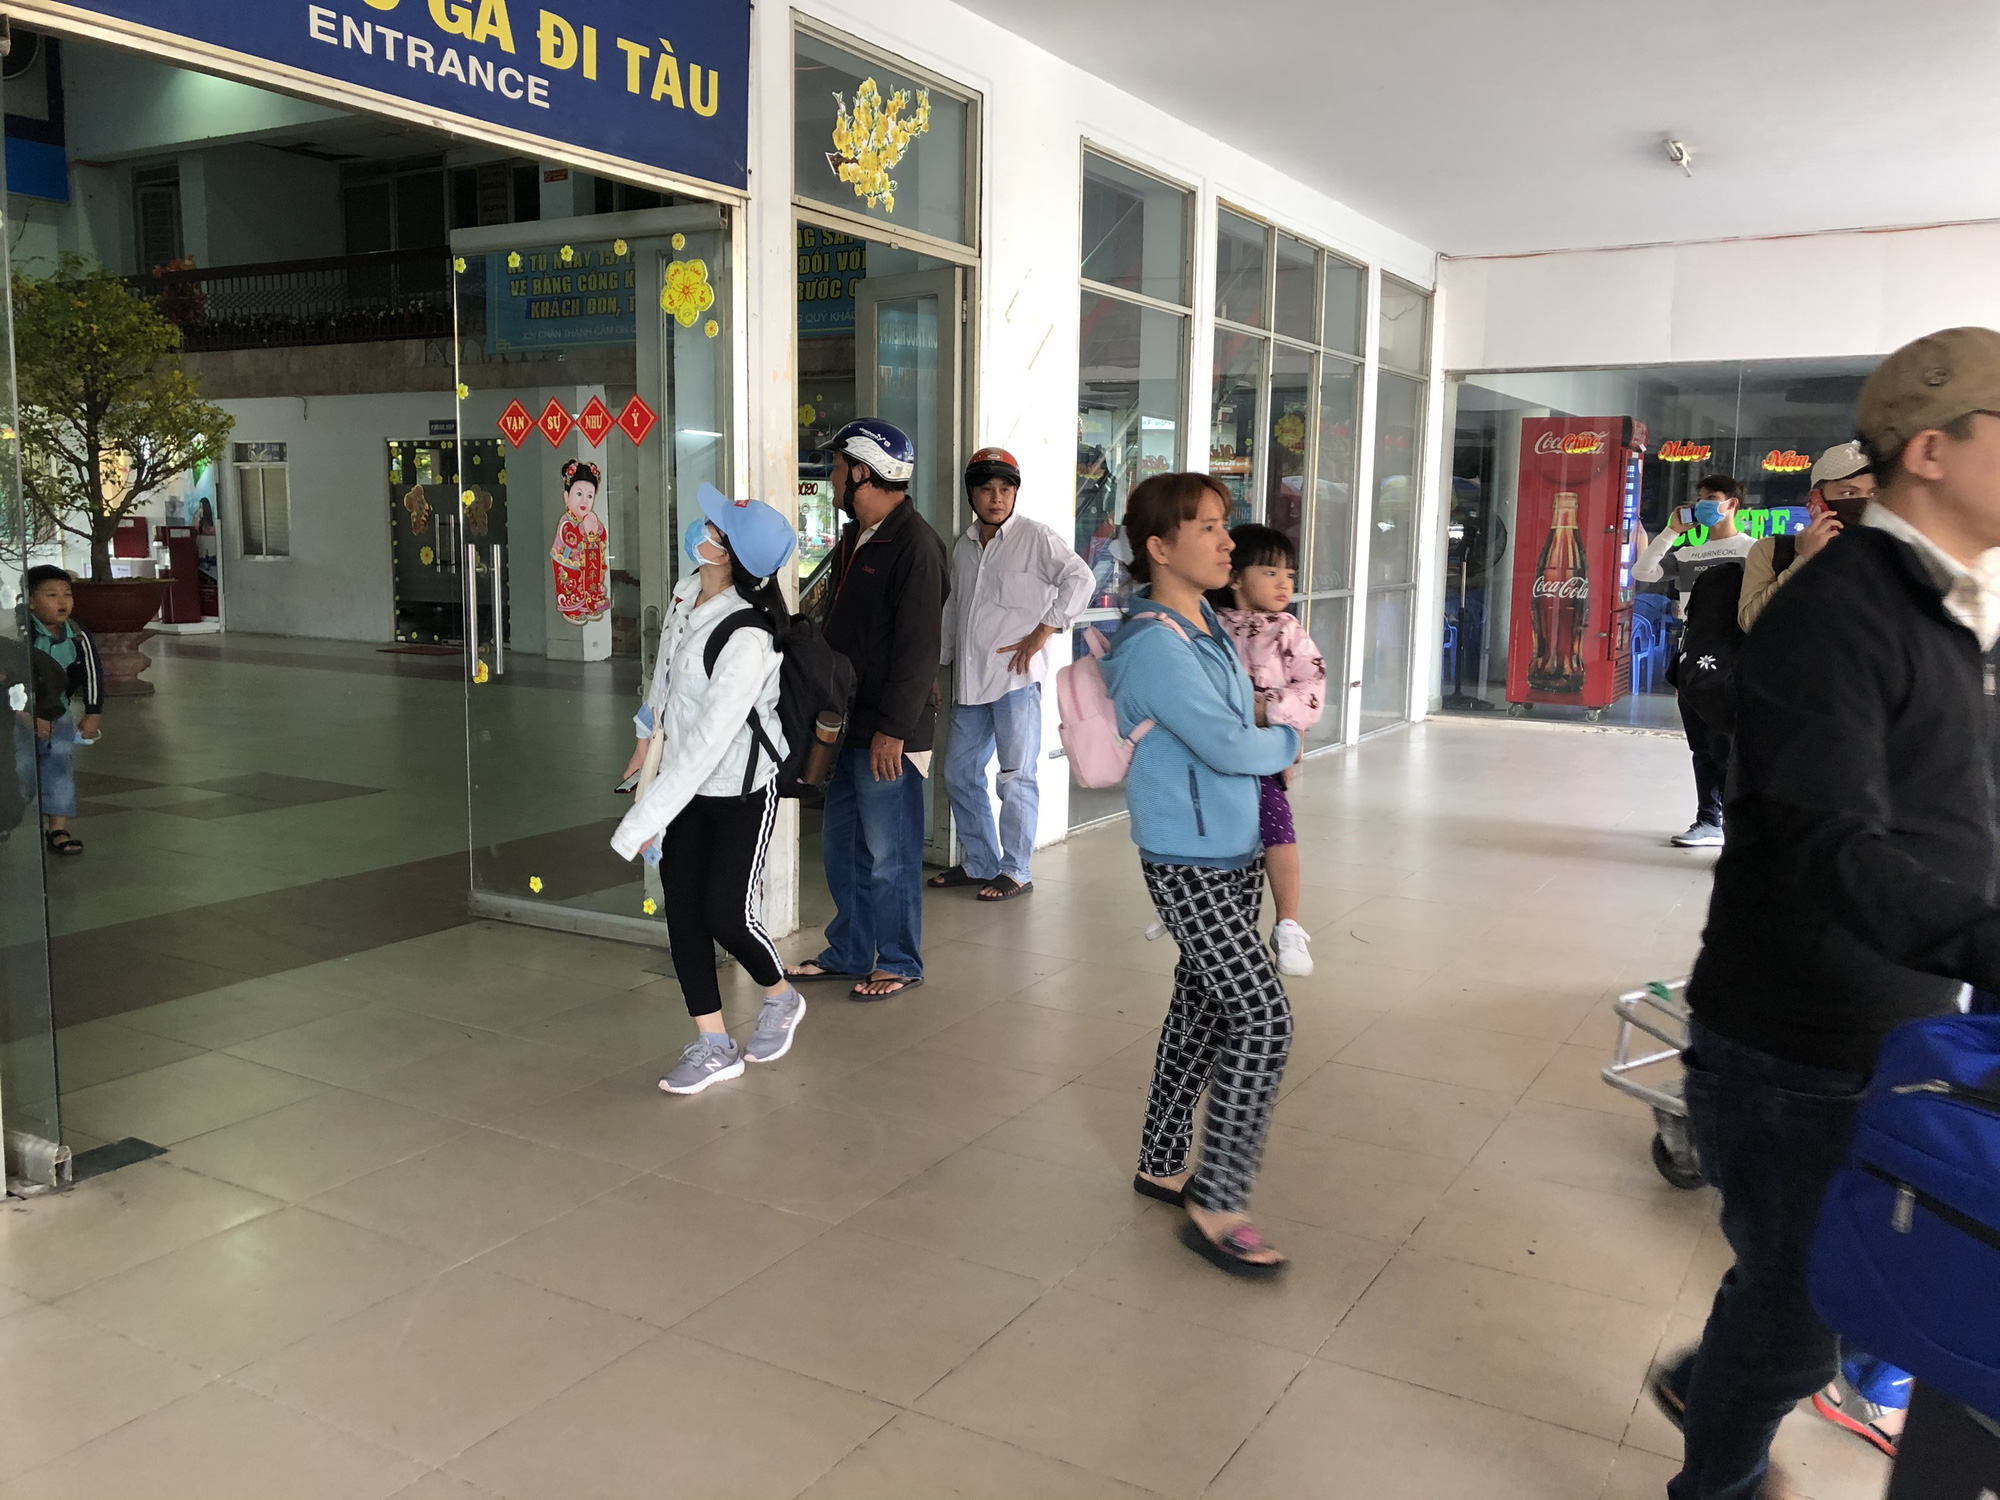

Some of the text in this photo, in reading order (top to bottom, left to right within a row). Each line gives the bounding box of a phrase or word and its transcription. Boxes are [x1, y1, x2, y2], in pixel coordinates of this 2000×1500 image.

[309, 4, 550, 109] ENTRANCE
[428, 0, 719, 117] GA ĐI TÀU
[798, 247, 830, 274] ĐỐI
[797, 277, 842, 301] RƯỚC
[531, 297, 580, 318] KHÁCH
[830, 309, 856, 322] KHÁC
[506, 409, 640, 432] VẠN SỰ NHƯ Ý
[1658, 440, 1811, 470] Mừng Năm
[1532, 575, 1589, 599] Coca-Cola
